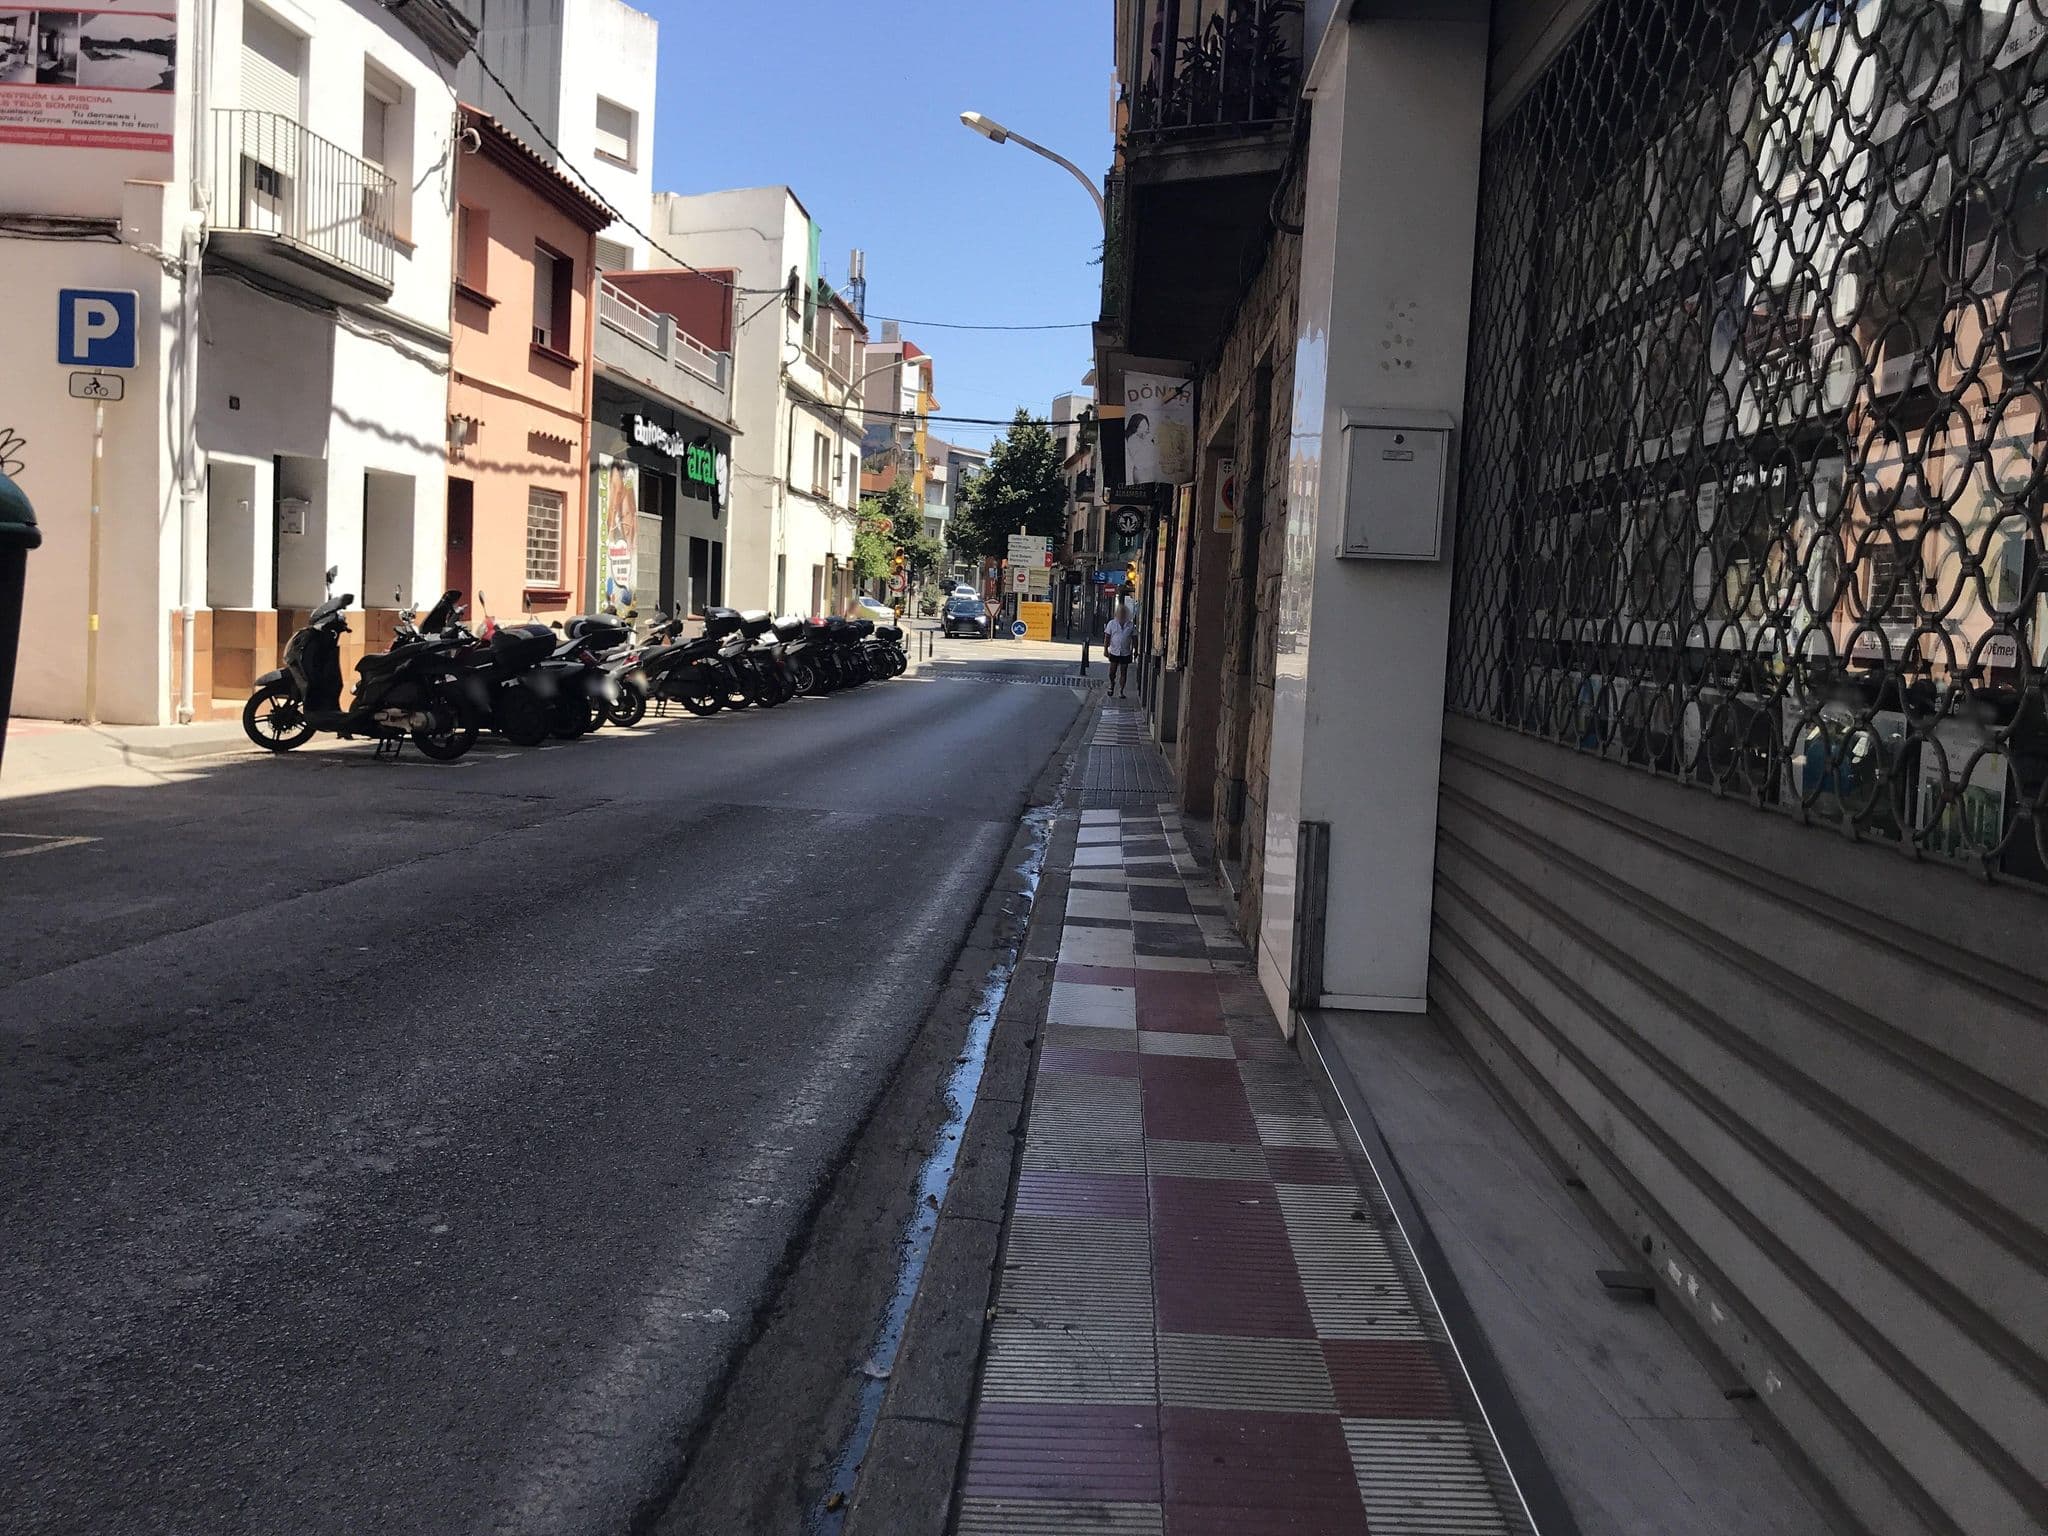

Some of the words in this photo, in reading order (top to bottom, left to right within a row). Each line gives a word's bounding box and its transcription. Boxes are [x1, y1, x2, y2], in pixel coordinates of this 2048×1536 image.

[45, 102, 89, 110] SOMNIS
[68, 95, 112, 103] PISCINA
[73, 298, 120, 358] P
[687, 442, 716, 486] aral
